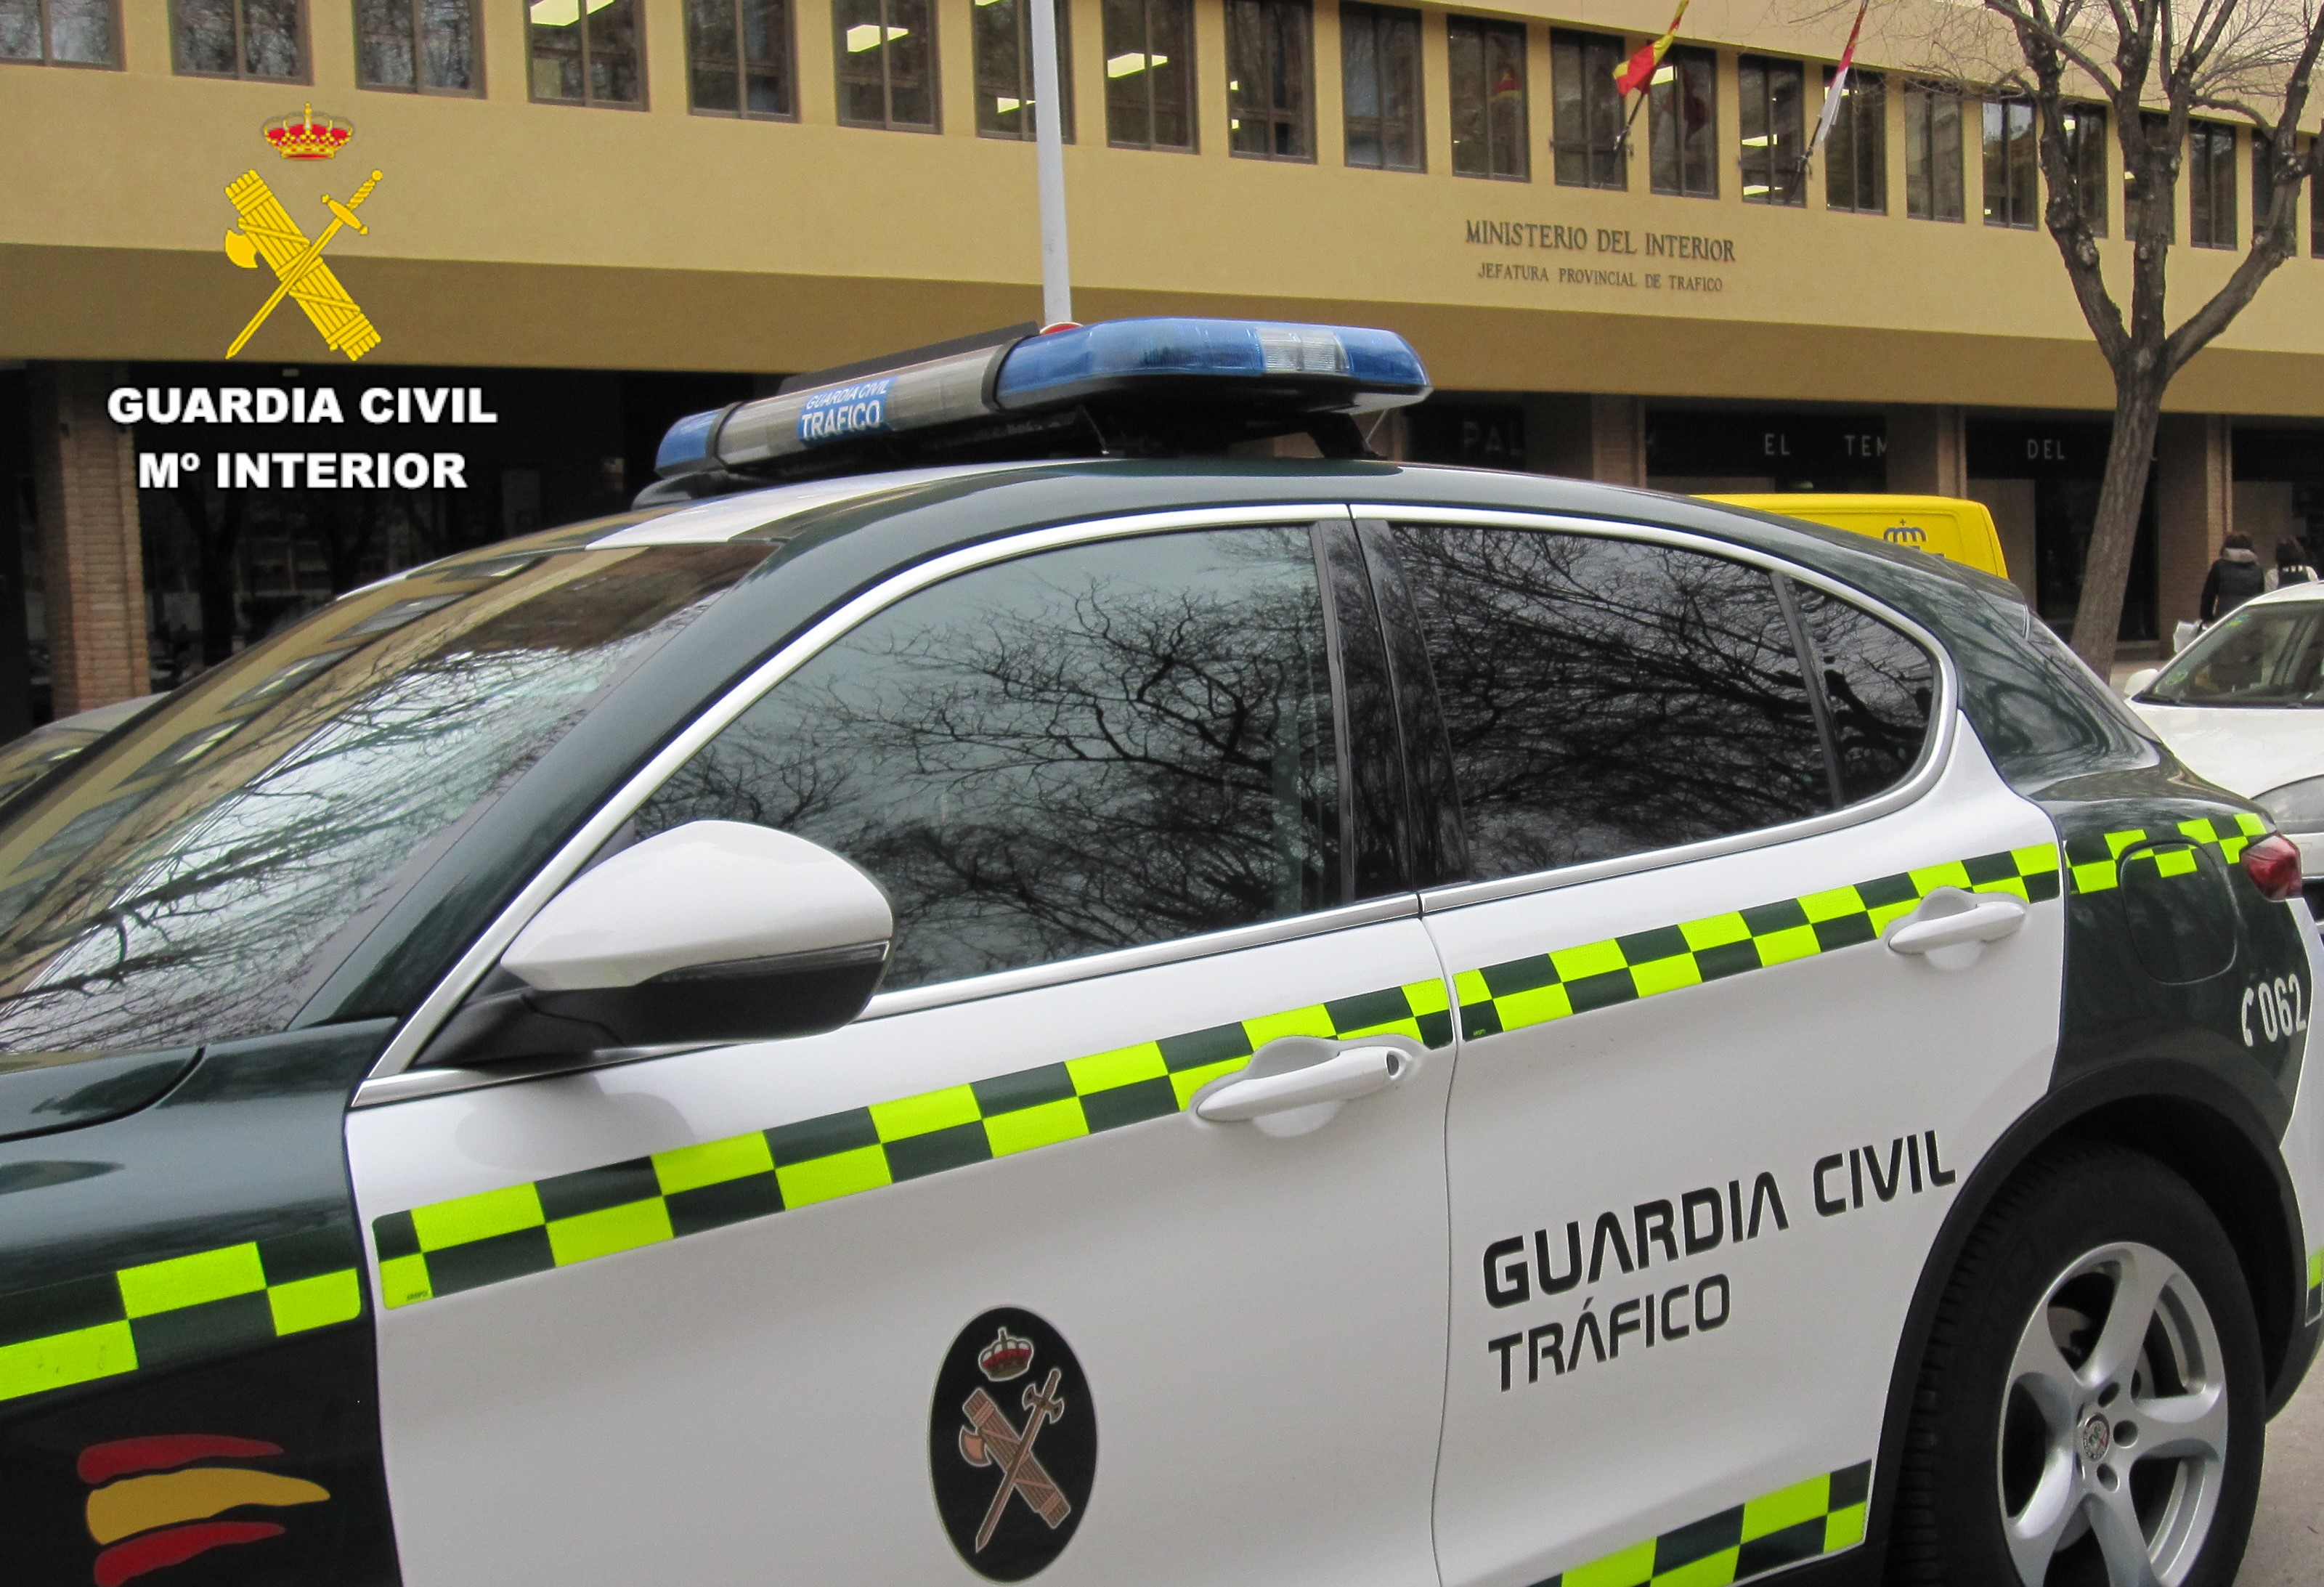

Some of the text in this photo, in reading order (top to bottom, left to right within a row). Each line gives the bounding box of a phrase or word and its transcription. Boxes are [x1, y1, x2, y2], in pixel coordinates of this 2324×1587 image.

[1466, 219, 1735, 261] MINISTERIO DEL INTERIOR
[1479, 262, 1723, 291] JEFATURA PROVINCIAL DE TRAFICO
[806, 380, 890, 410] GUARDIA CIVIL
[801, 399, 880, 440] TRAFICO
[1765, 434, 1790, 455] EL
[2028, 439, 2065, 460] DEL
[2258, 973, 2307, 1042] 062
[1483, 1129, 1957, 1309] GUARDIA CIVIL
[1488, 1273, 1731, 1393] TRÁFICO
